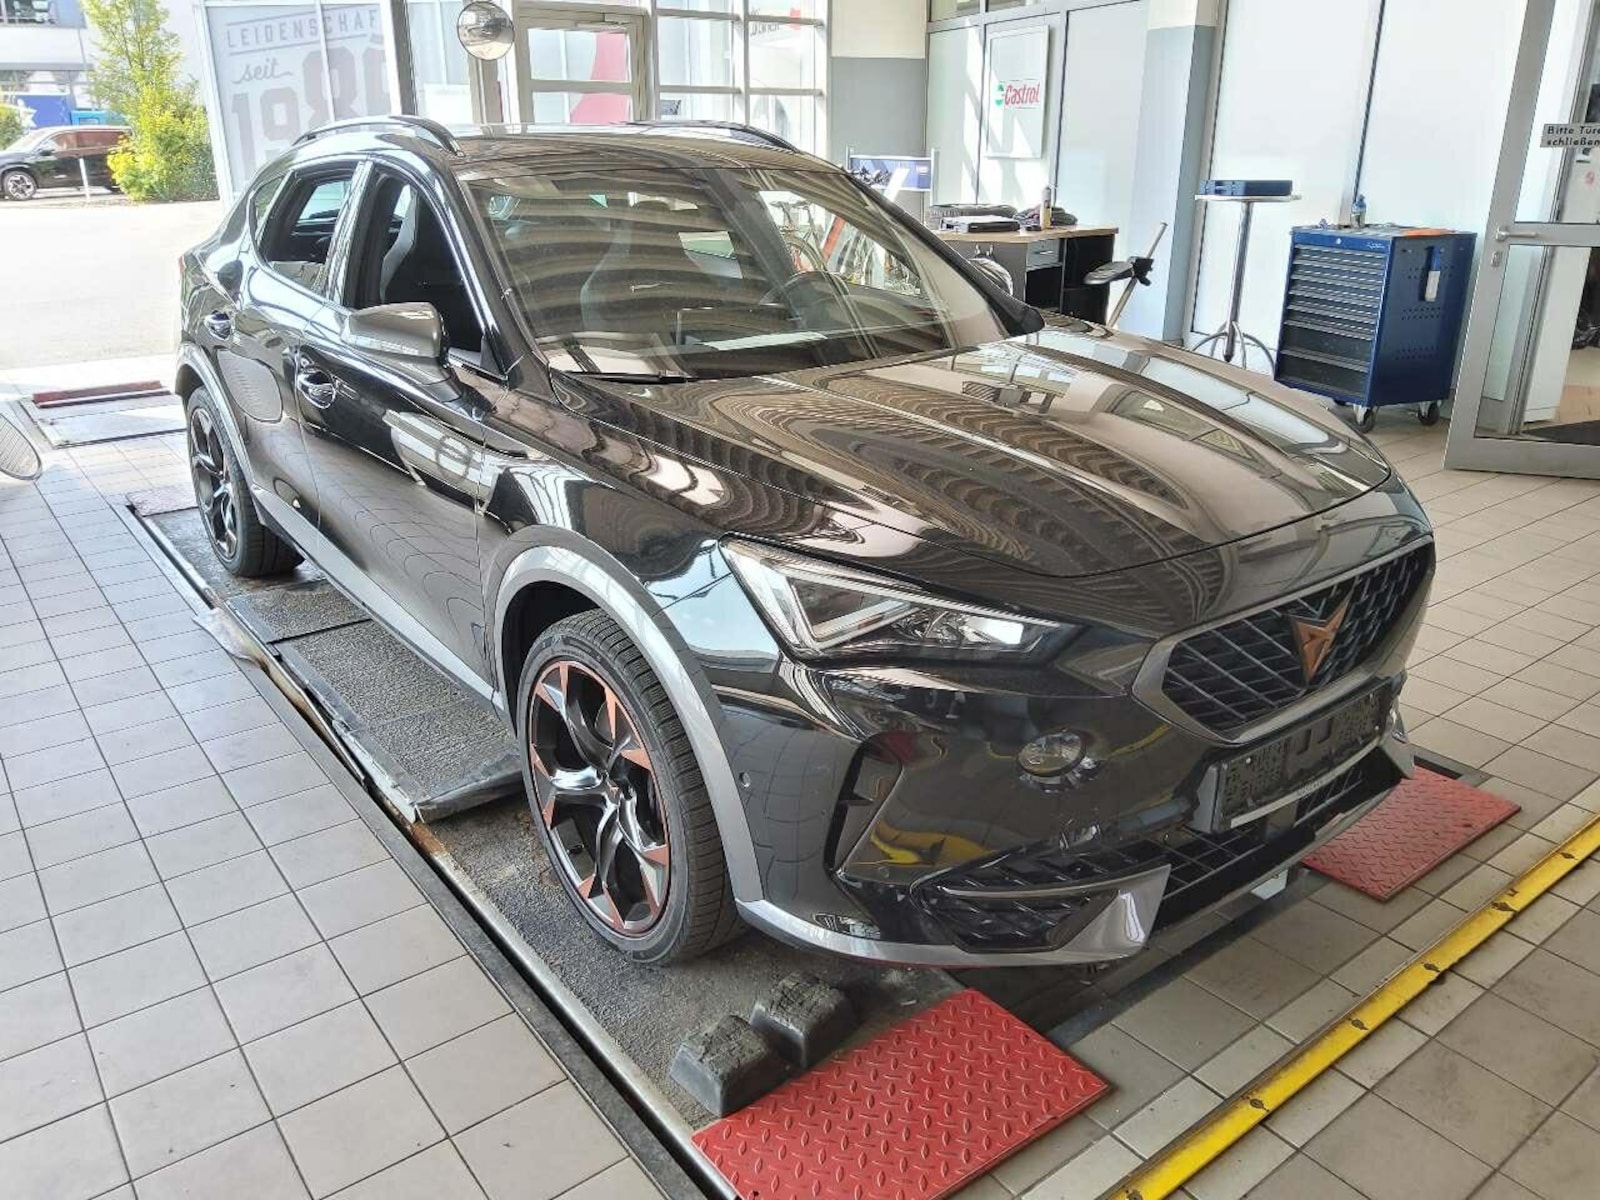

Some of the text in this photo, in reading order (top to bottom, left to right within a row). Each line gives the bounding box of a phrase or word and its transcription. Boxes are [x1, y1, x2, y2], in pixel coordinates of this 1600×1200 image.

[227, 9, 378, 48] LEIDENSCHAF
[232, 57, 294, 84] seit
[1004, 83, 1041, 106] Castrol
[1547, 125, 1575, 134] Bitte
[1547, 136, 1600, 146] schließen
